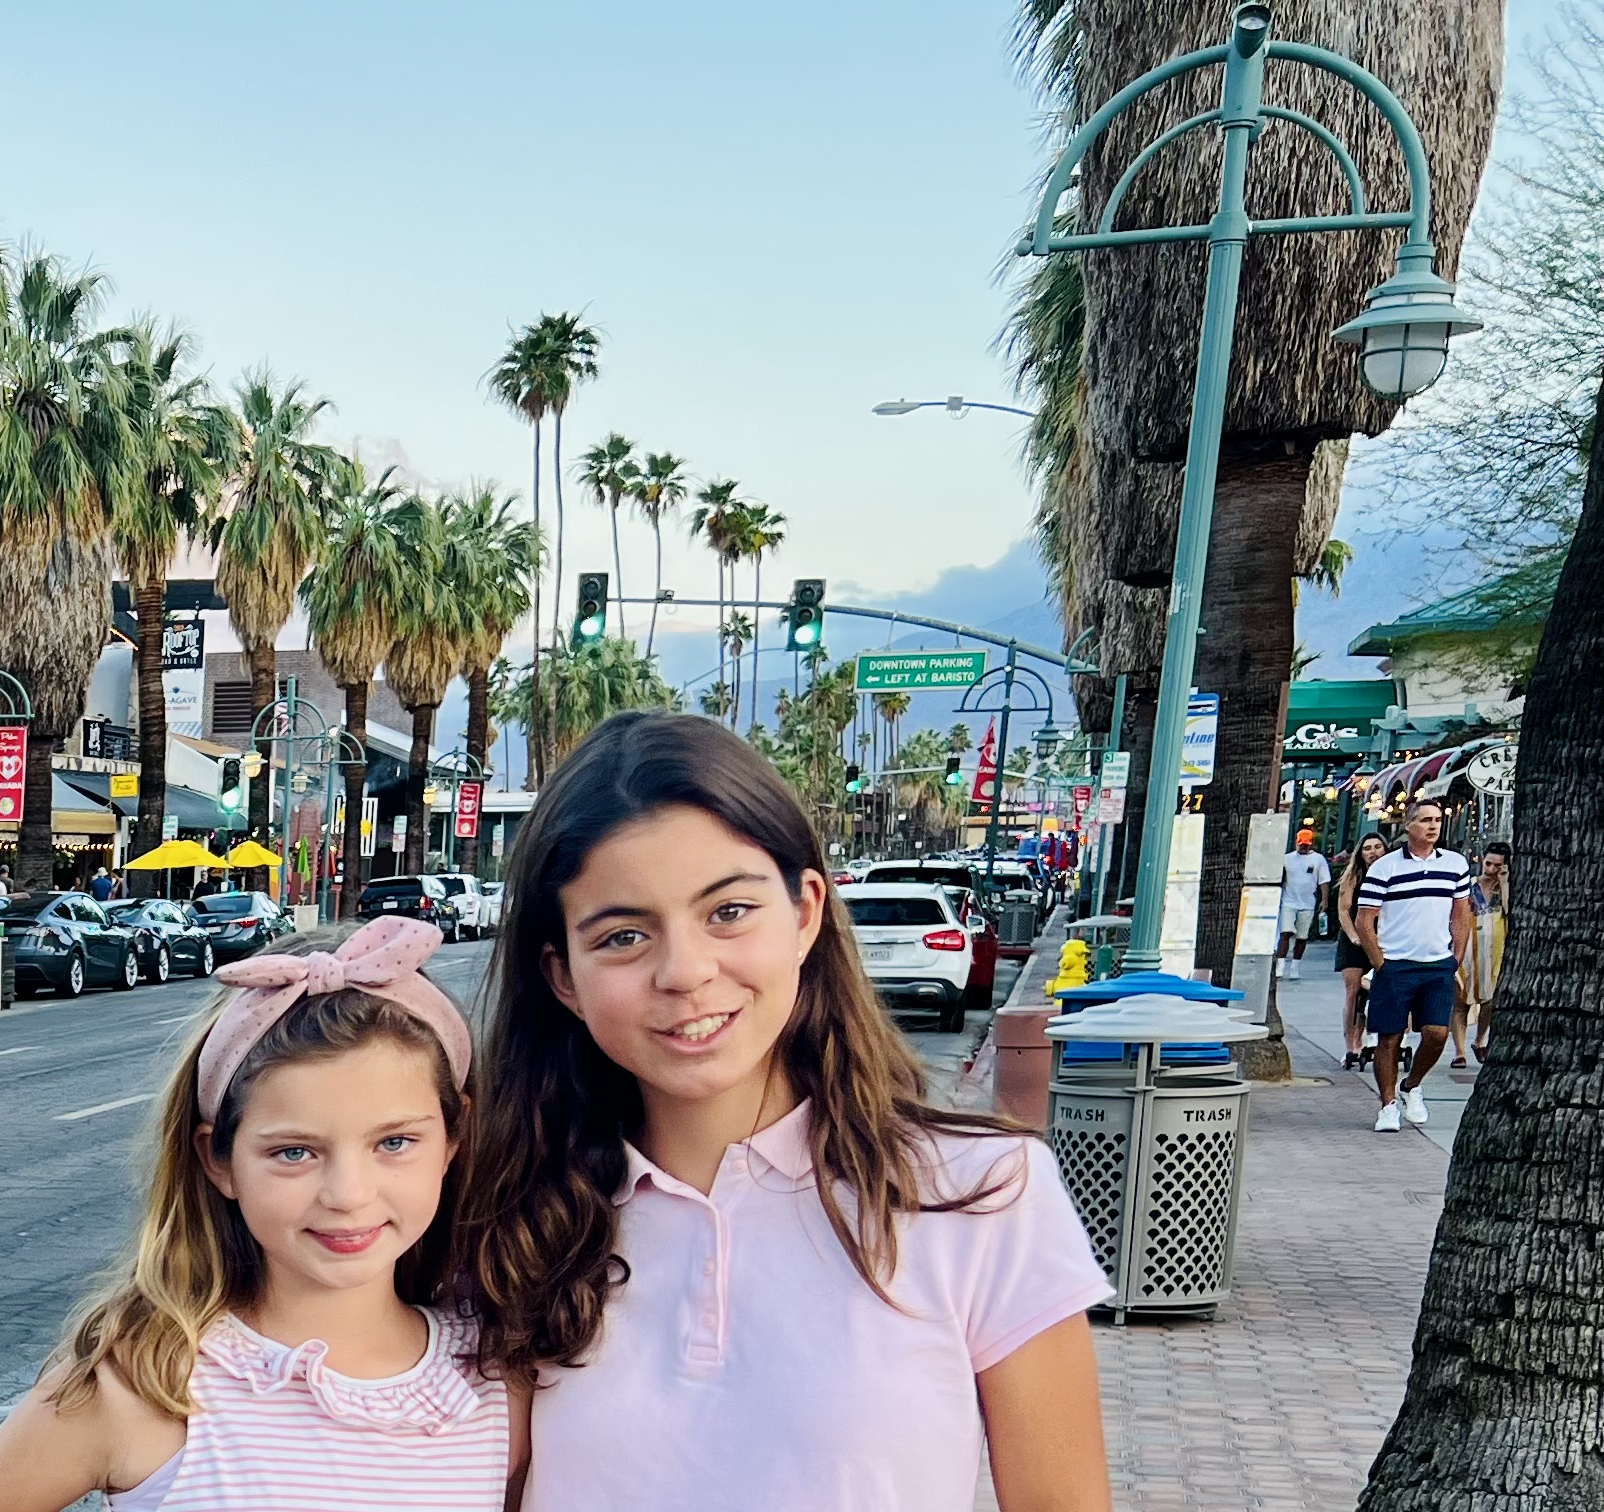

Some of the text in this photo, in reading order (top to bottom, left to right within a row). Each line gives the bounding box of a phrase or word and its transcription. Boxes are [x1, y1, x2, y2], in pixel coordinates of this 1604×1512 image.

[869, 657, 973, 670] DOWNTOWN PARKING
[884, 671, 975, 684] LEFT AT BARISTO
[1060, 1106, 1105, 1121] TRASH
[1184, 1108, 1232, 1122] TRASH
